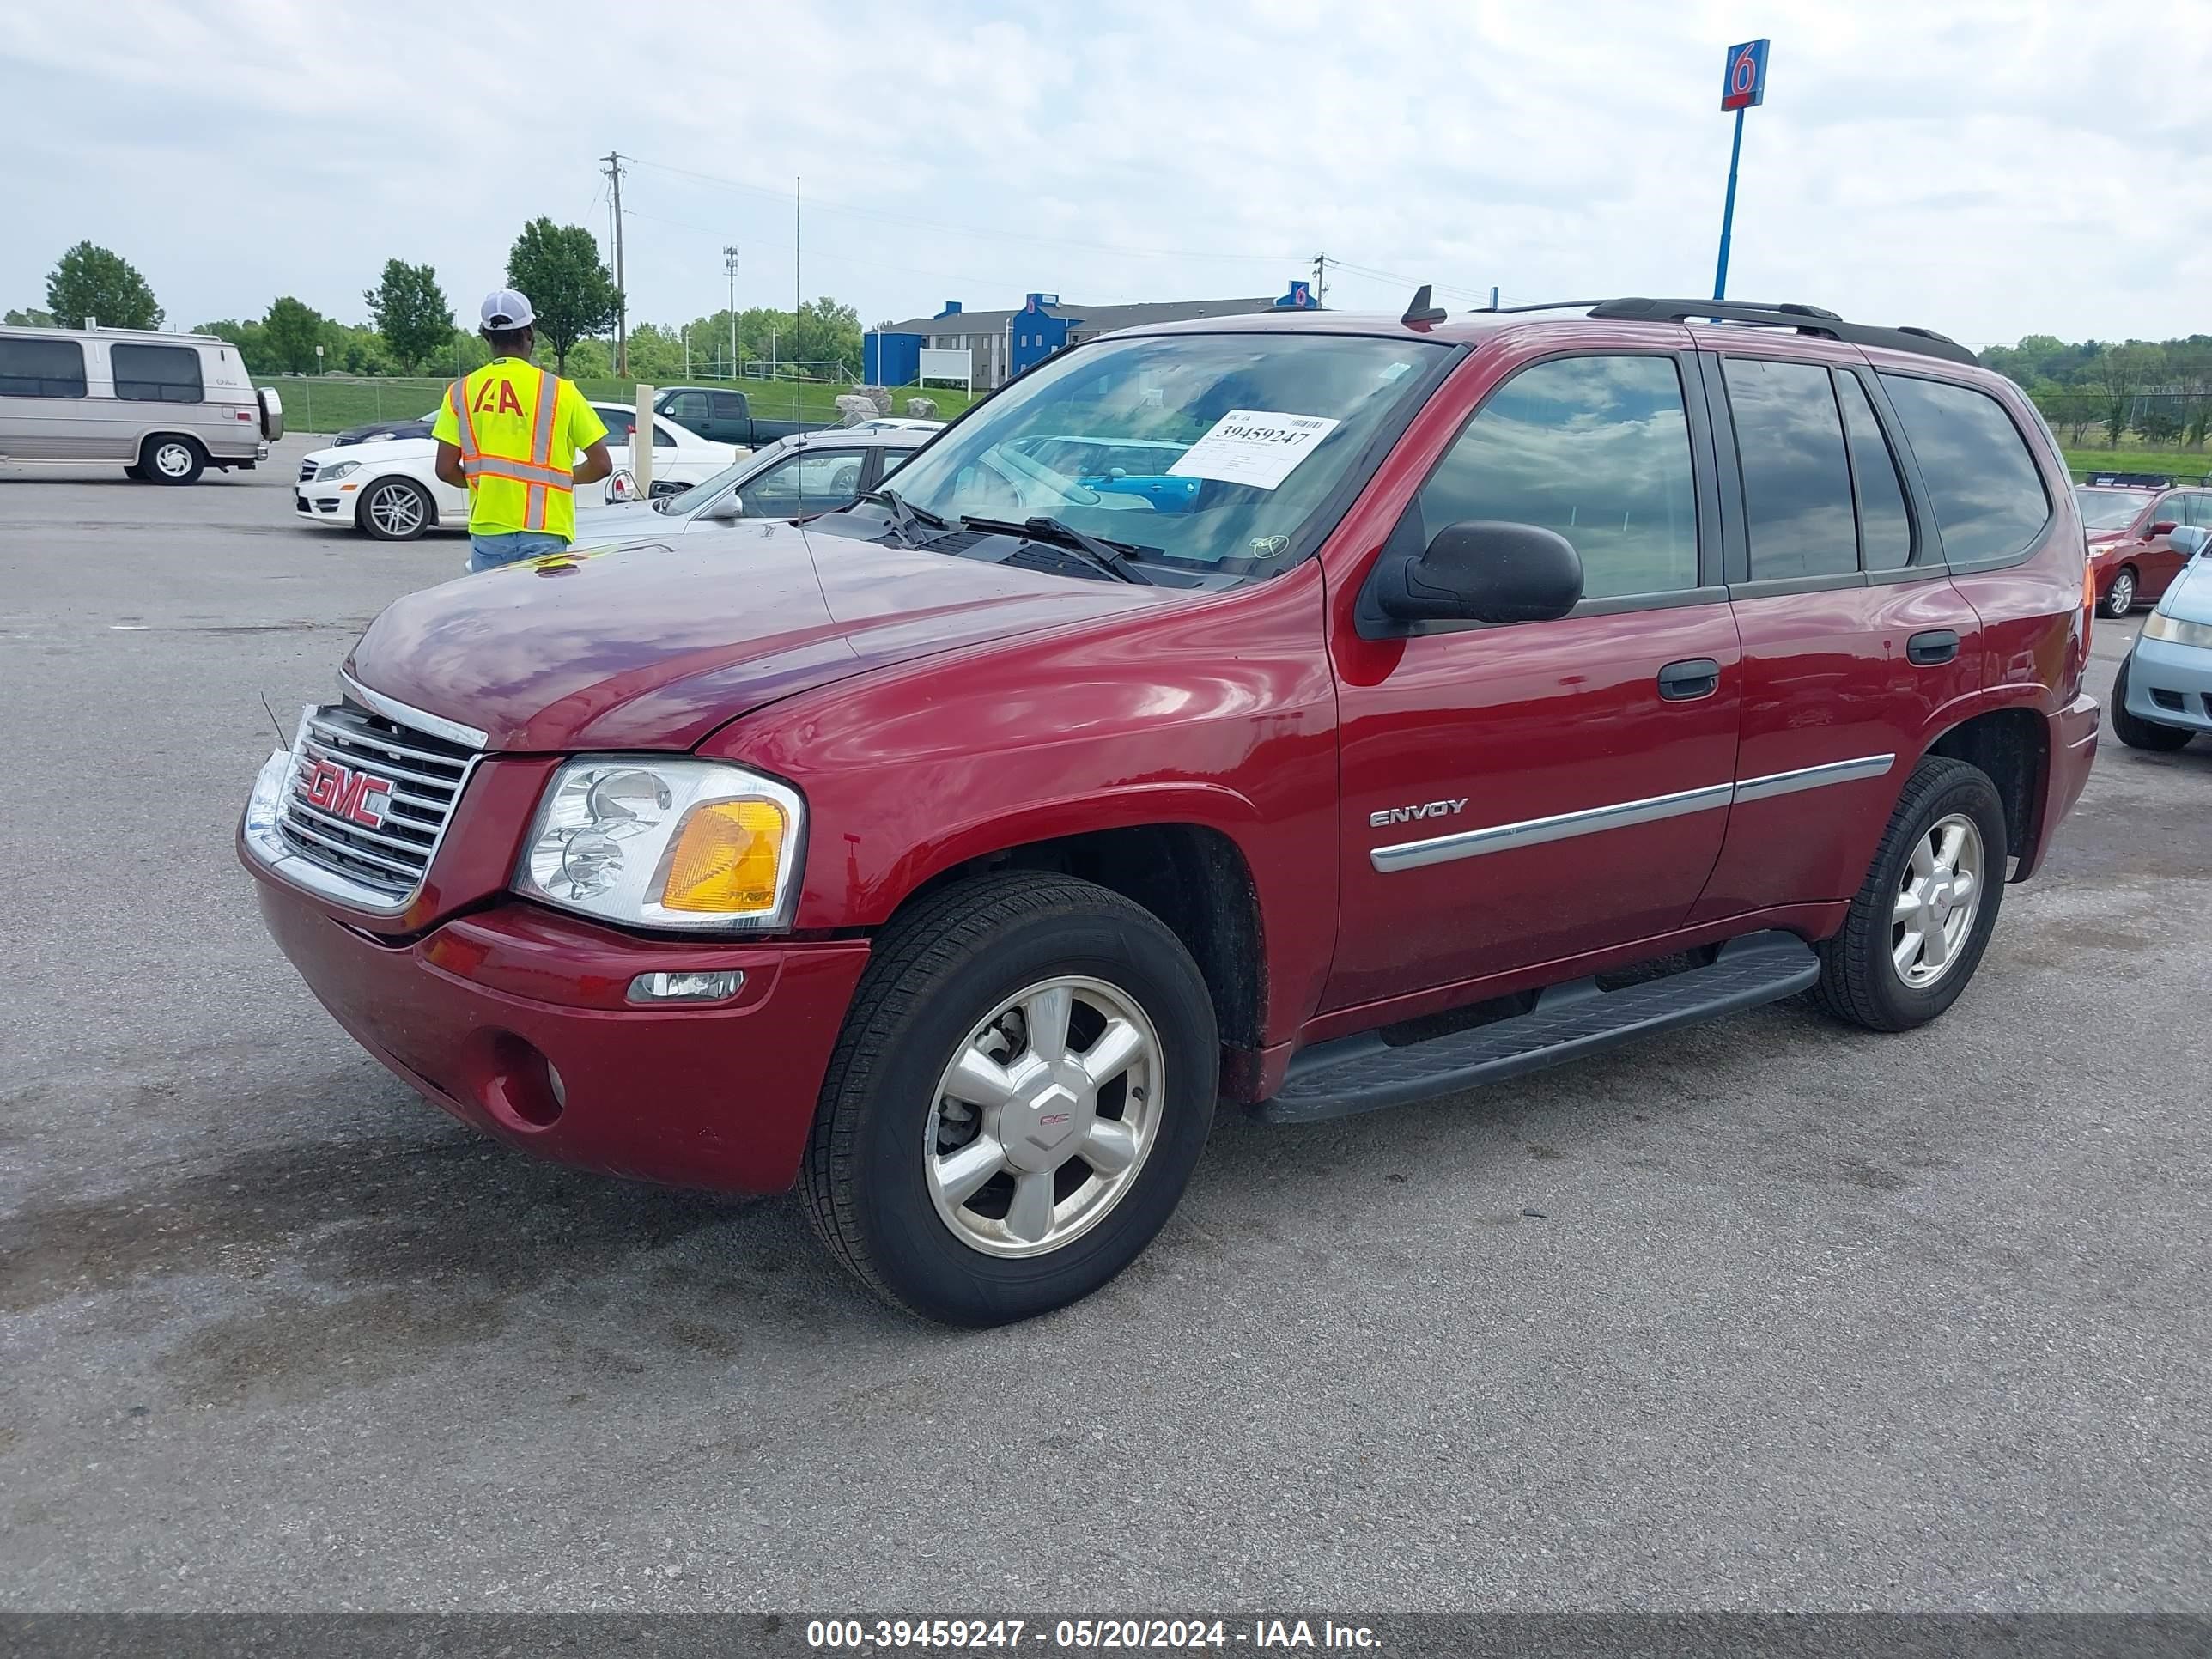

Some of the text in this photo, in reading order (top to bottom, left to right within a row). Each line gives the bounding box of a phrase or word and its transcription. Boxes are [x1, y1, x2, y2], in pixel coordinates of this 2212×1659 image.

[1731, 42, 1756, 95] 6
[1027, 295, 1036, 314] 6
[1296, 285, 1306, 307] 6
[1216, 426, 1310, 446] 39459247
[307, 759, 398, 830] GMC
[1370, 797, 1469, 828] ENVOY
